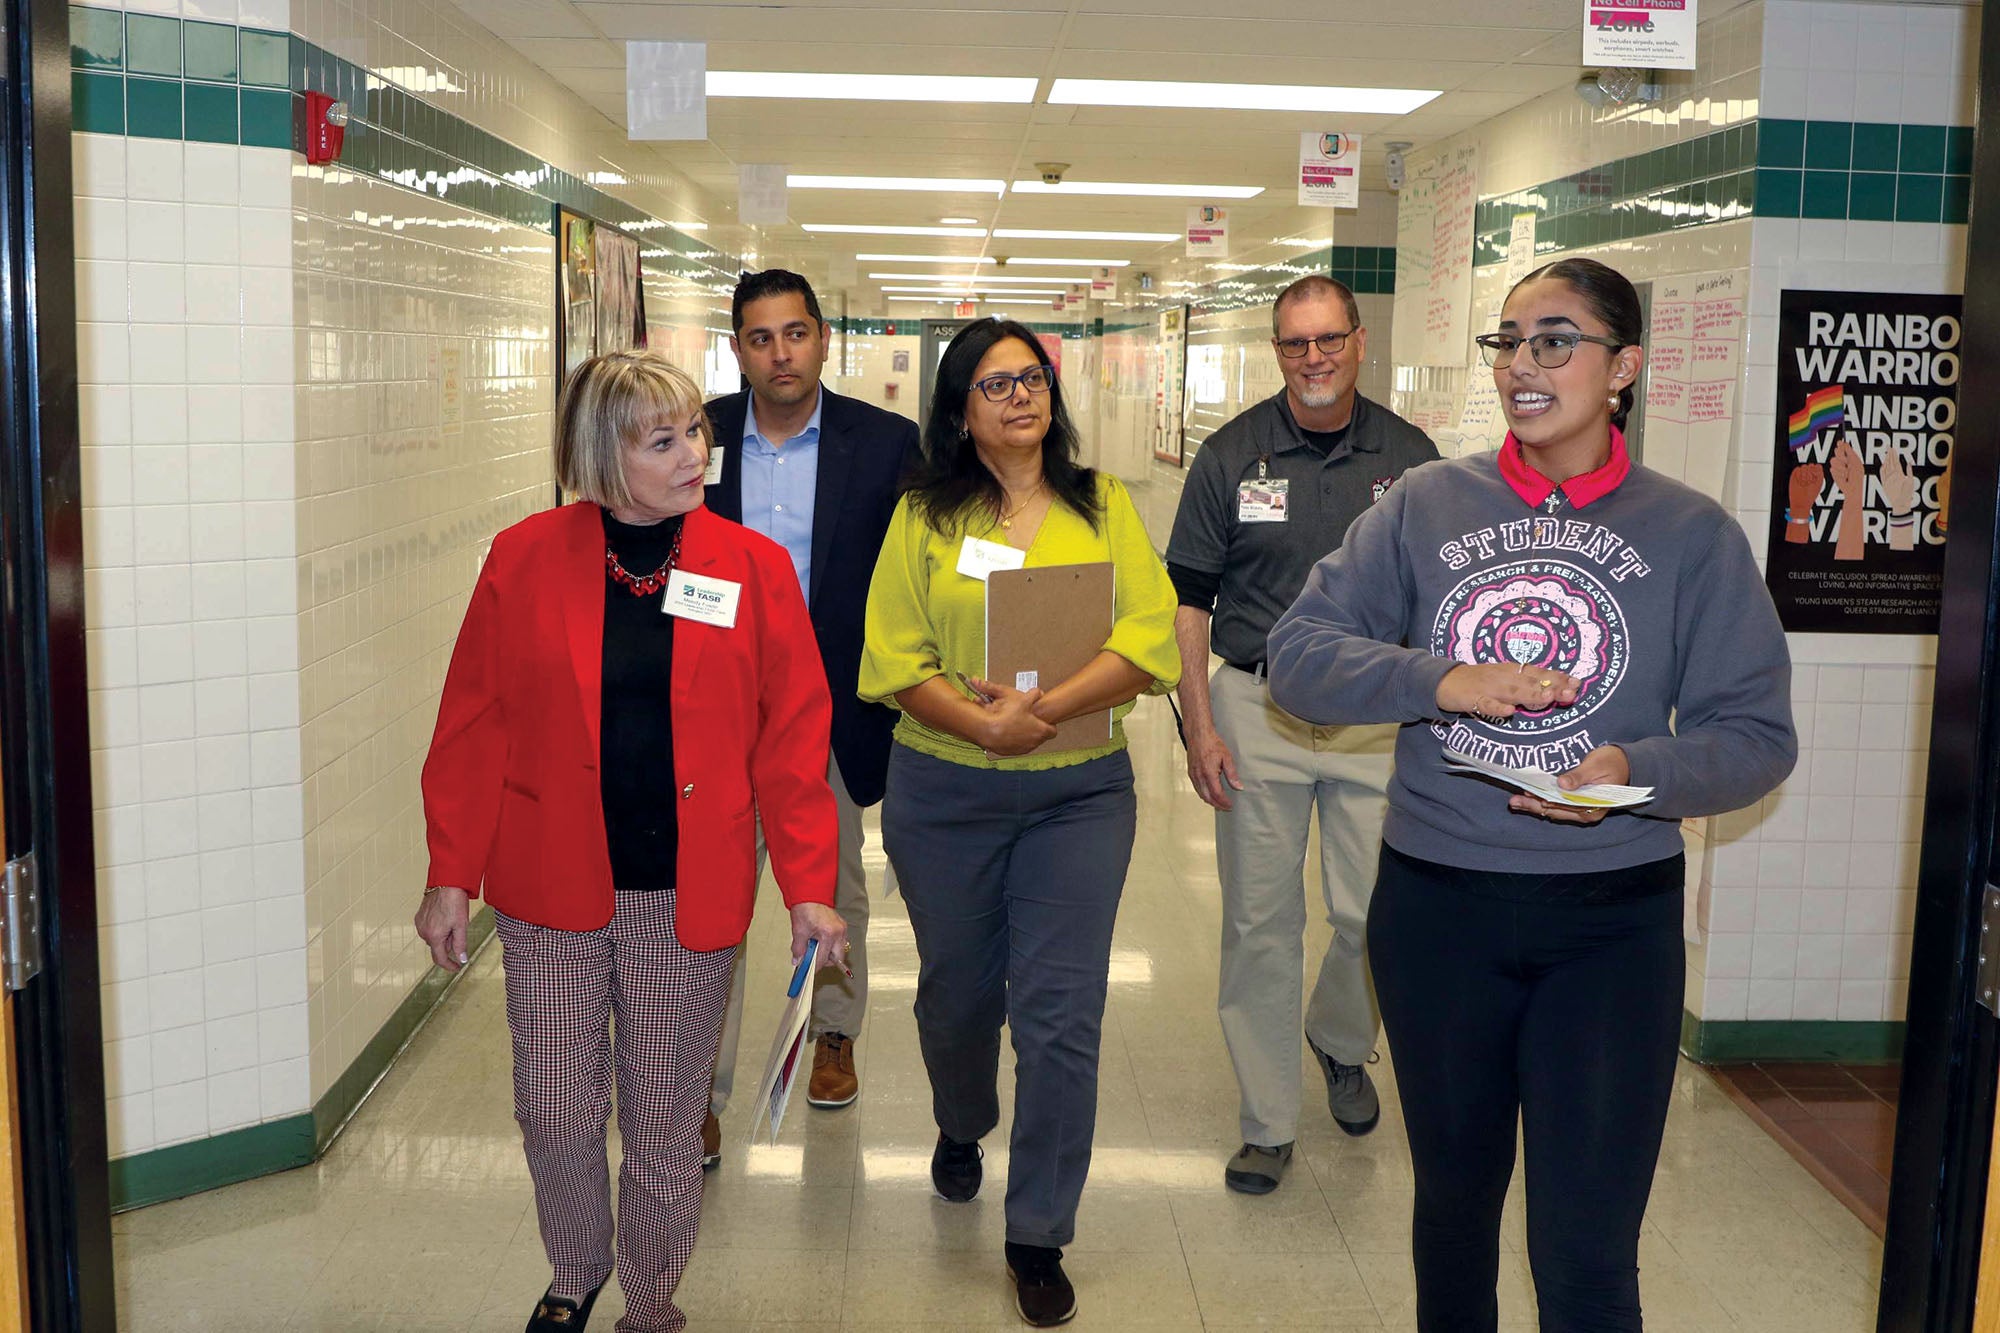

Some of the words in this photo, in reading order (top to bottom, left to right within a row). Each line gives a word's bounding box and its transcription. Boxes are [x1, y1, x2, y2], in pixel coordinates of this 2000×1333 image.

[1643, 0, 1682, 8] Phone
[1596, 12, 1655, 33] Zone
[956, 302, 975, 316] EXIT
[1808, 311, 1960, 350] RAINBO
[1795, 347, 1960, 386] WARRIO
[1806, 392, 1956, 431] AINBO
[1440, 517, 1652, 582] STUDENT
[1788, 571, 1828, 580] CELEBRATE
[1871, 573, 1898, 581] SPREAD
[1848, 581, 1864, 589] AND
[1864, 581, 1911, 590] INFORMATIVE
[697, 592, 721, 603] TASB
[1795, 597, 1821, 605] YOUNG
[1855, 598, 1880, 606] STEAM
[1880, 598, 1917, 607] RESEARCH
[1844, 606, 1868, 614] QUEER
[1868, 606, 1903, 615] STRAIGHT
[1435, 600, 1457, 645] STEAM
[1455, 565, 1526, 600] RESEARCH
[1530, 564, 1539, 573] &
[1597, 633, 1622, 696] ACADEMY
